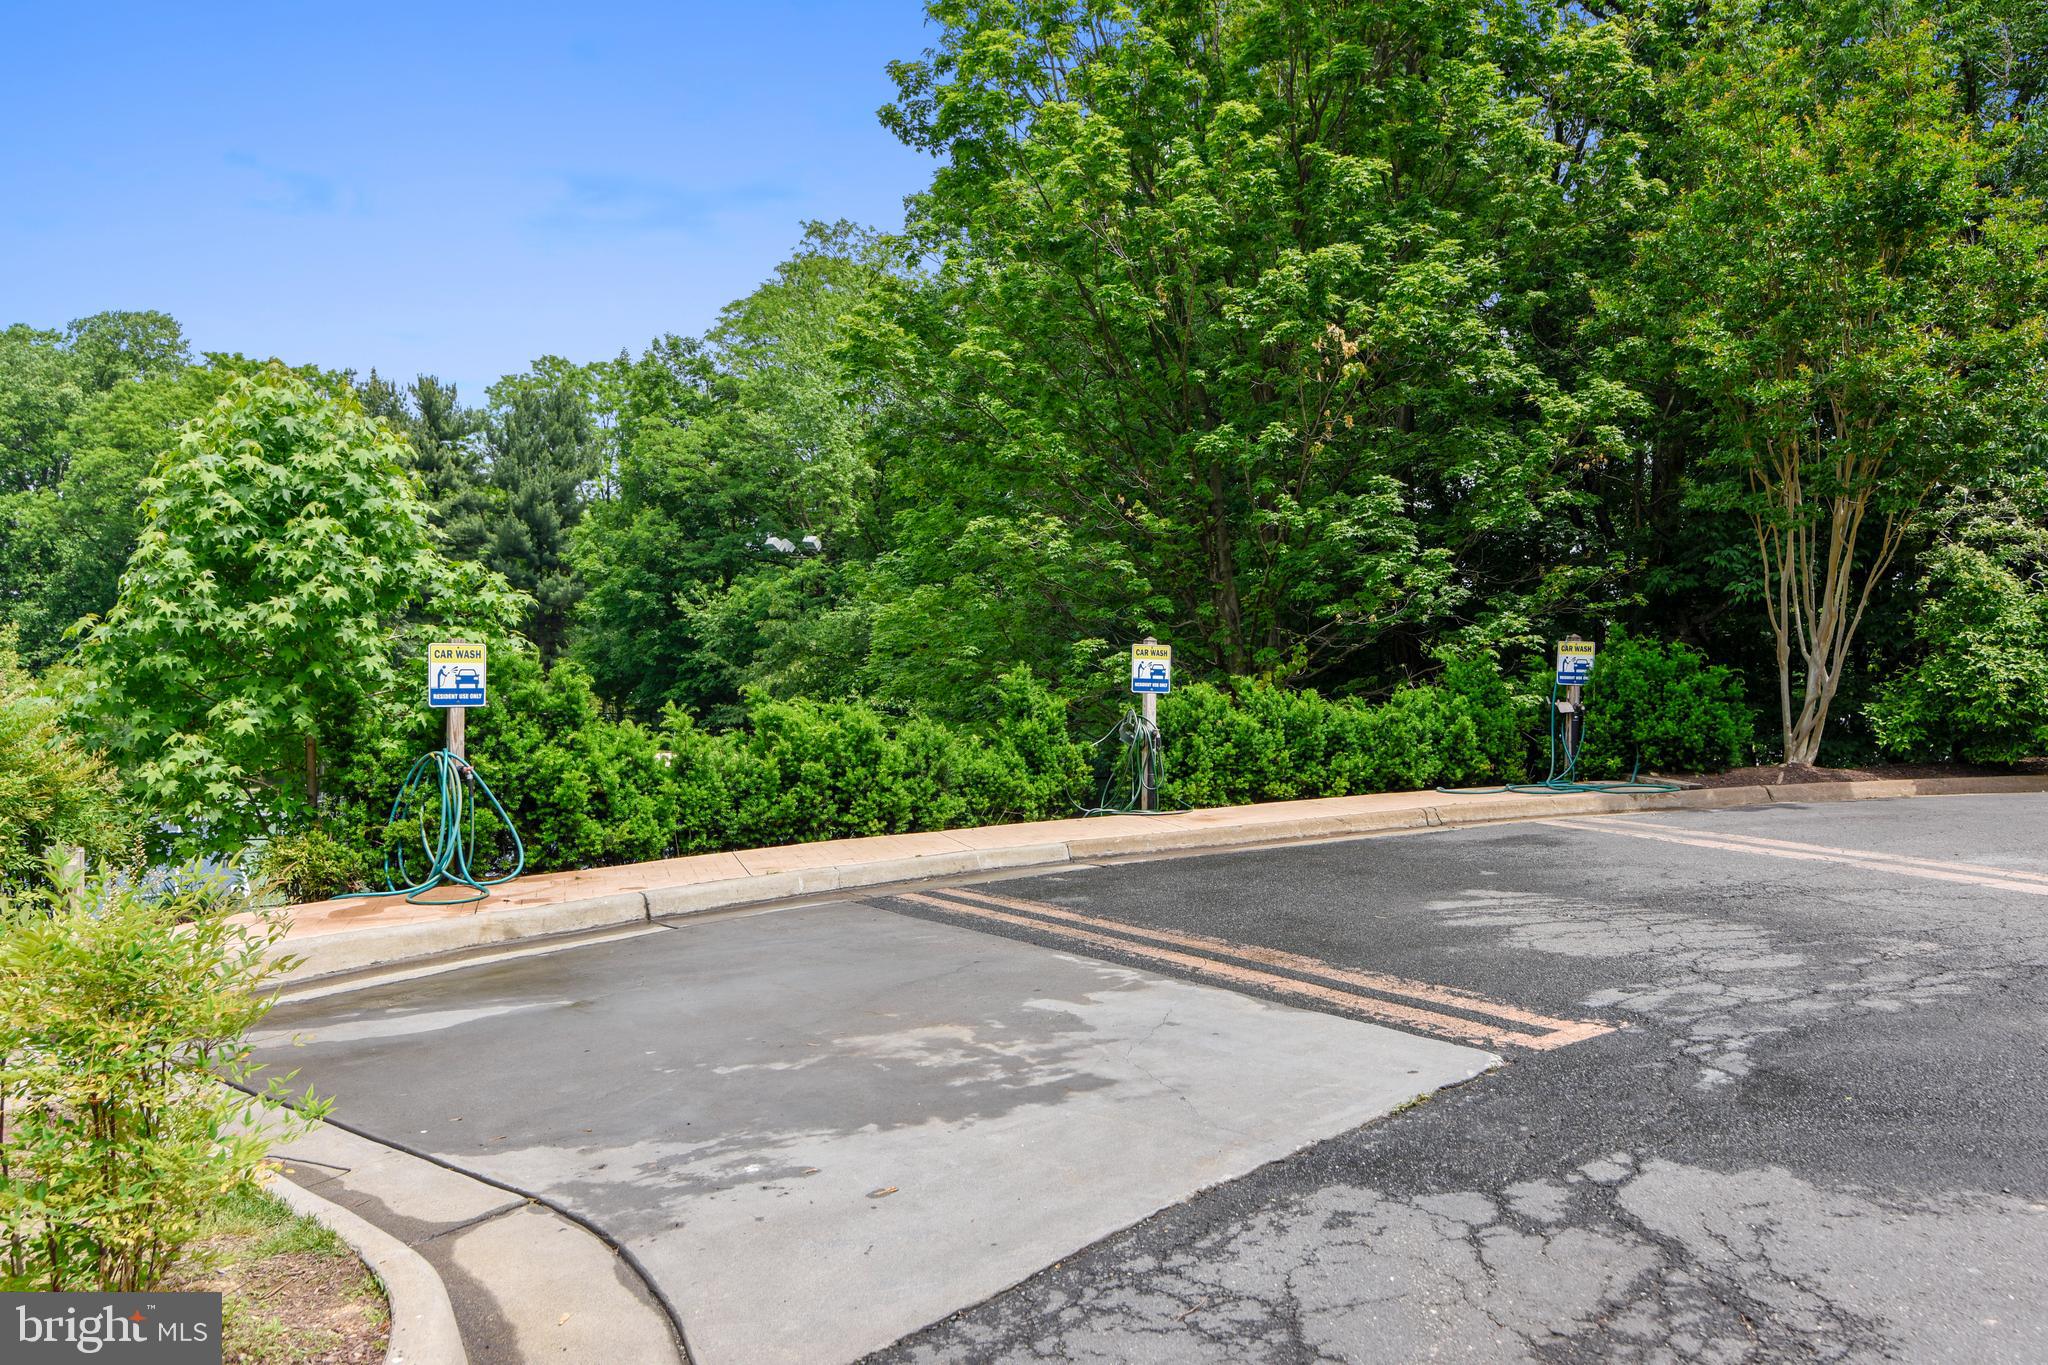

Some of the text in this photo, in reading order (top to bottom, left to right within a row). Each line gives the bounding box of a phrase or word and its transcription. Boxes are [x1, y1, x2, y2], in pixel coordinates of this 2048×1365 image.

[434, 649, 482, 659] CAR WASH
[1151, 649, 1168, 657] WASH
